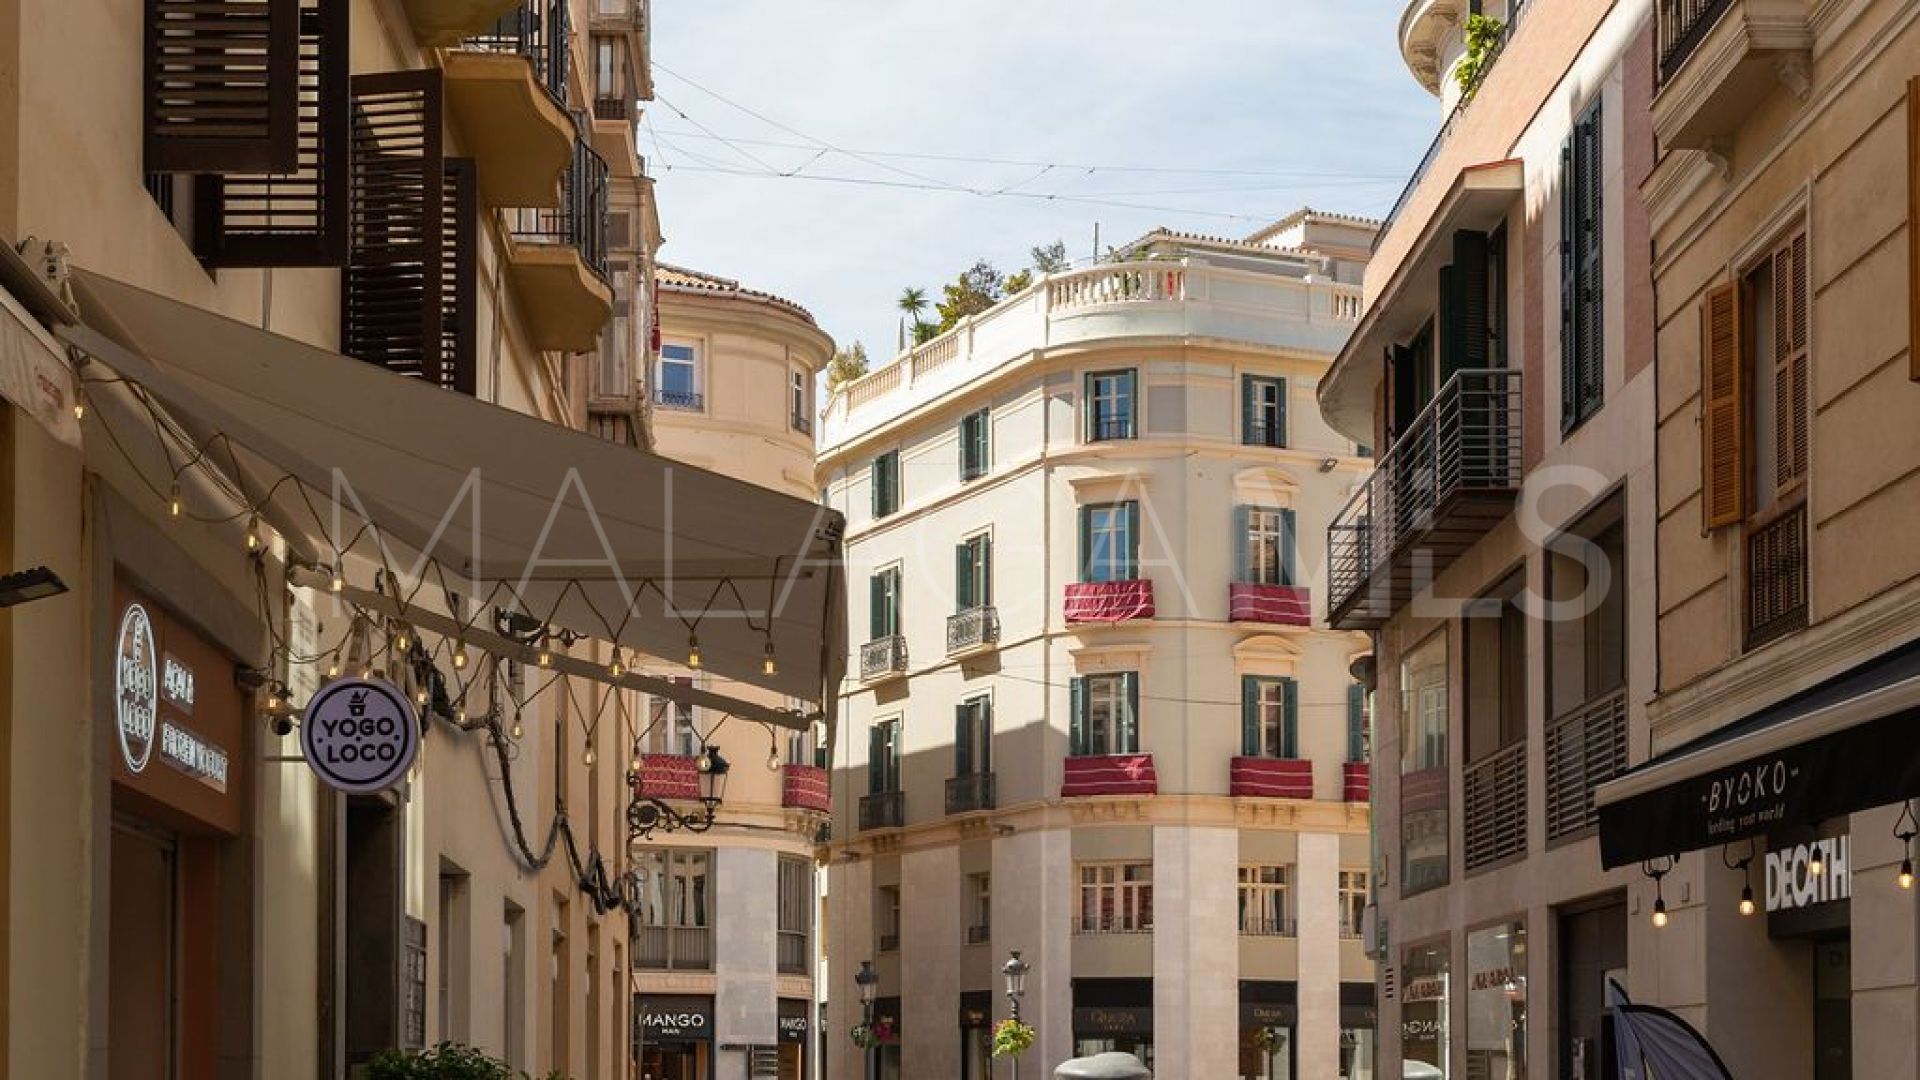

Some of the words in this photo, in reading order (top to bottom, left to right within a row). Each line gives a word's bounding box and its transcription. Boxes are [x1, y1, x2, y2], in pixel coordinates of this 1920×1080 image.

[322, 717, 396, 738] YOGO
[327, 743, 396, 764] LOCO
[1765, 833, 1851, 912] DECATH
[639, 1013, 704, 1027] MANGO
